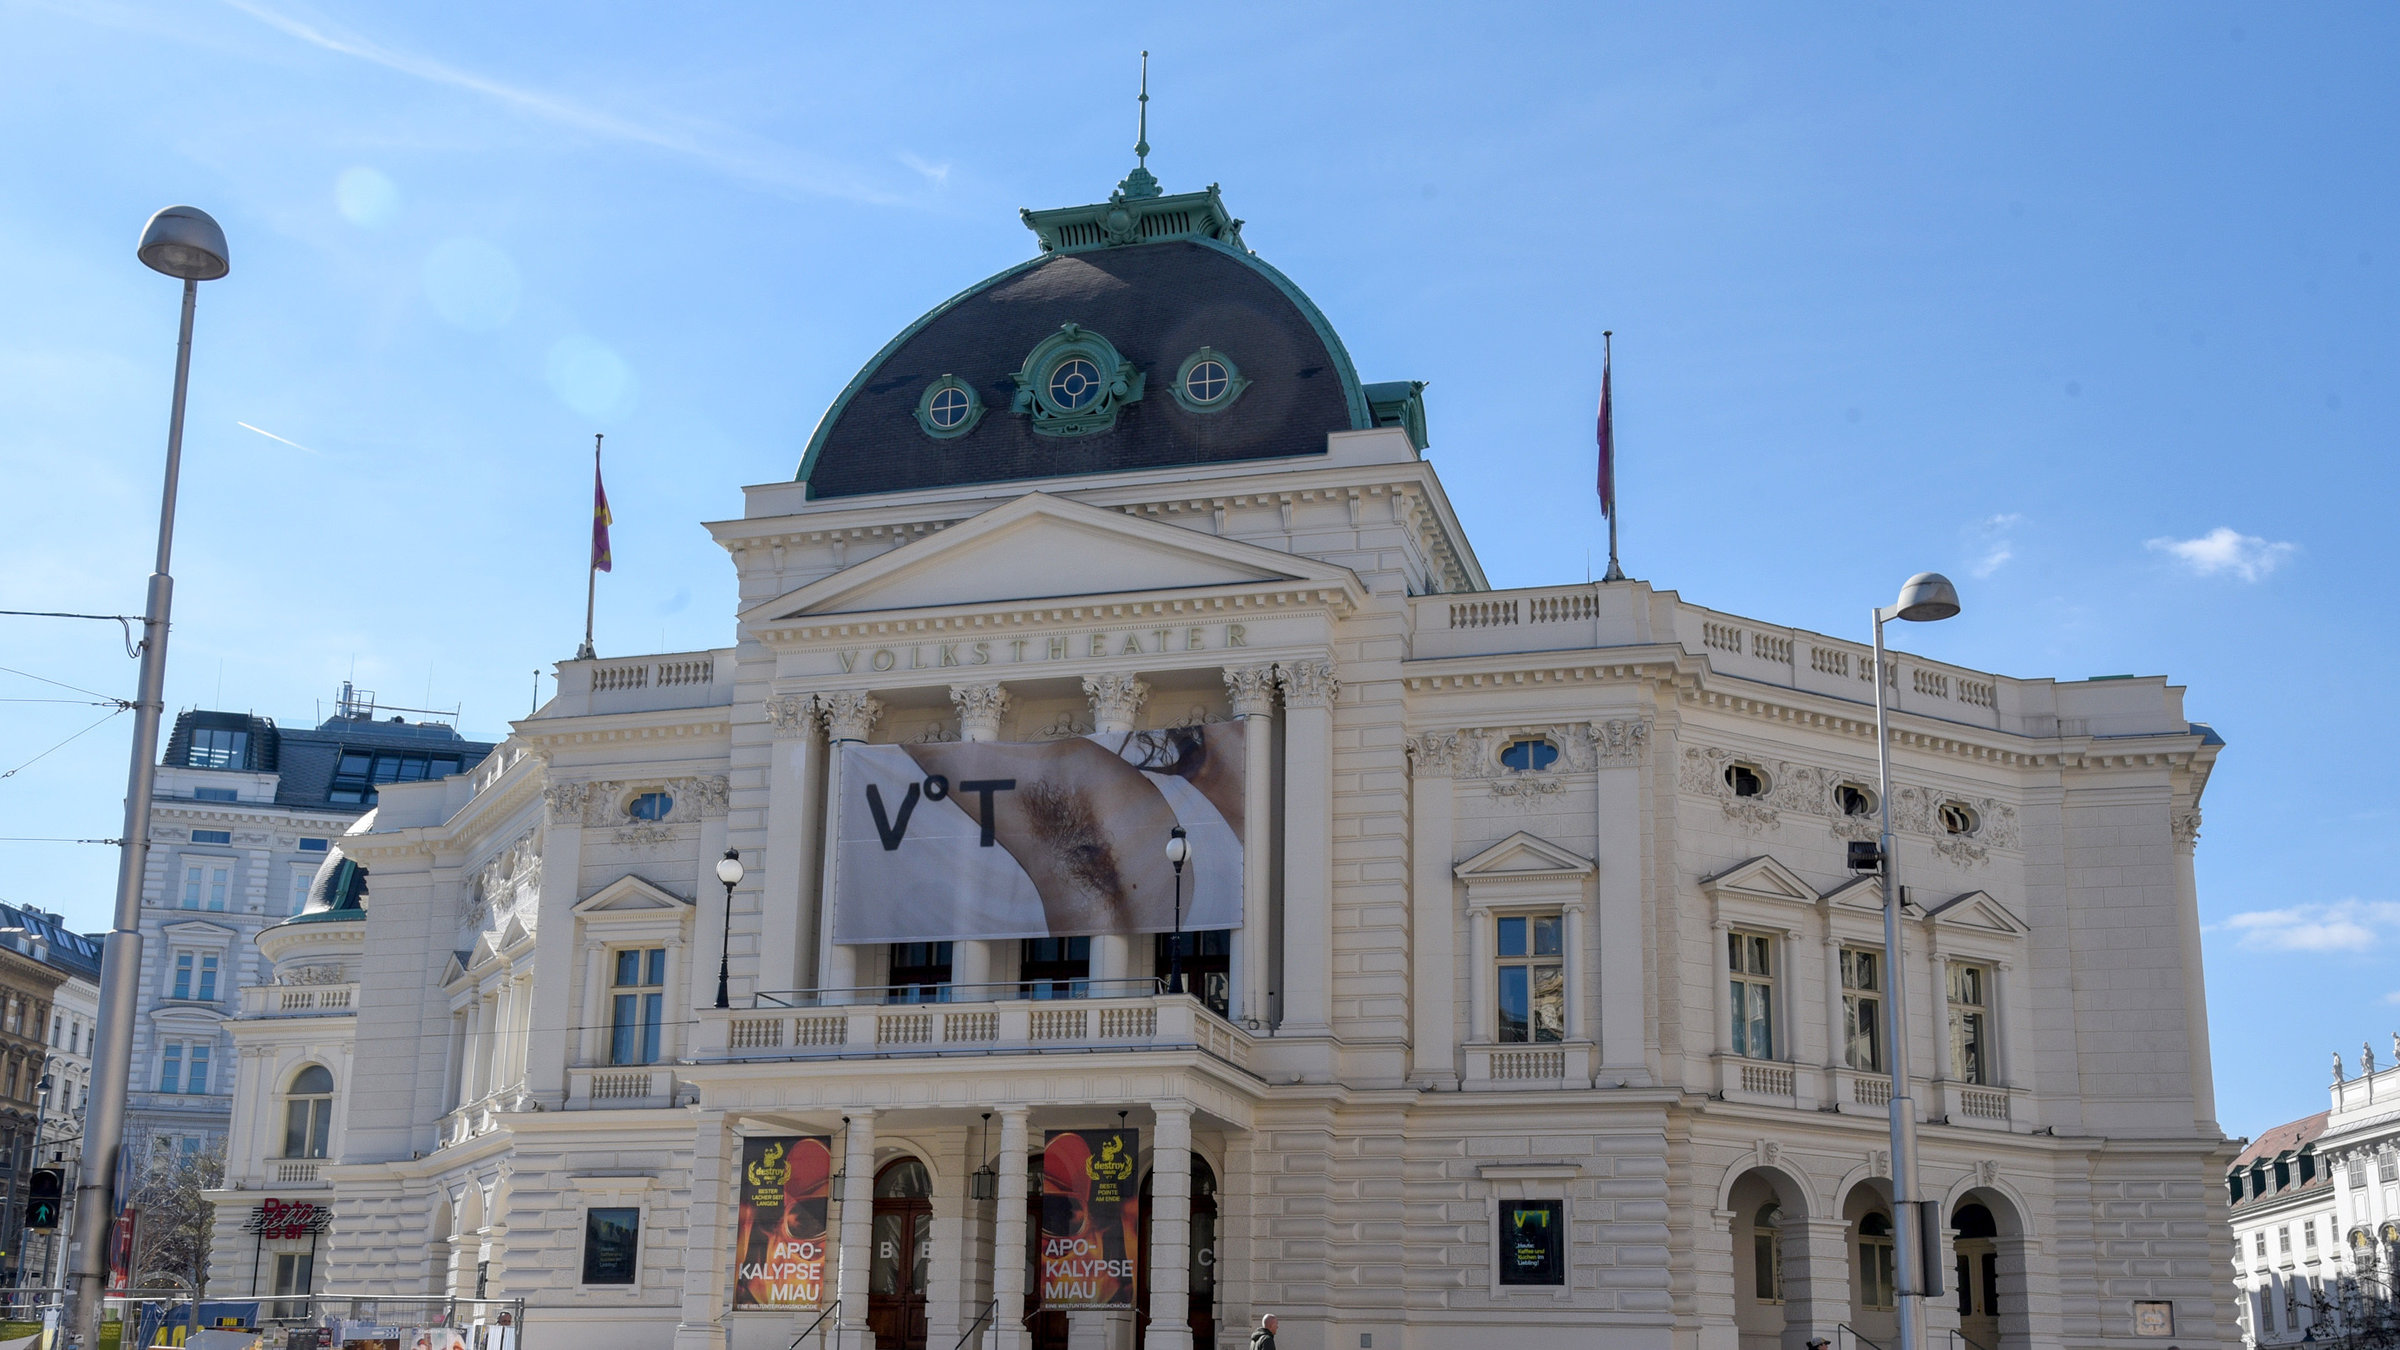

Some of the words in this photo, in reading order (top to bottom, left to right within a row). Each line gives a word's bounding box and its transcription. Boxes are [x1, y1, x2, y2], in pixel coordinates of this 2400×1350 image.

[837, 623, 1248, 674] VOLKSTHEATER
[756, 1167, 784, 1177] destroy
[1094, 1161, 1125, 1171] destroy
[265, 1221, 309, 1240] Bar
[773, 1242, 822, 1260] APO-
[880, 1241, 893, 1259] B
[1045, 1238, 1097, 1257] APO-
[1197, 1248, 1213, 1267] C
[739, 1262, 821, 1281] KALYPSE
[1045, 1260, 1134, 1278] KALYPSE
[770, 1284, 820, 1301] MIAU
[1045, 1281, 1097, 1299] MIAU
